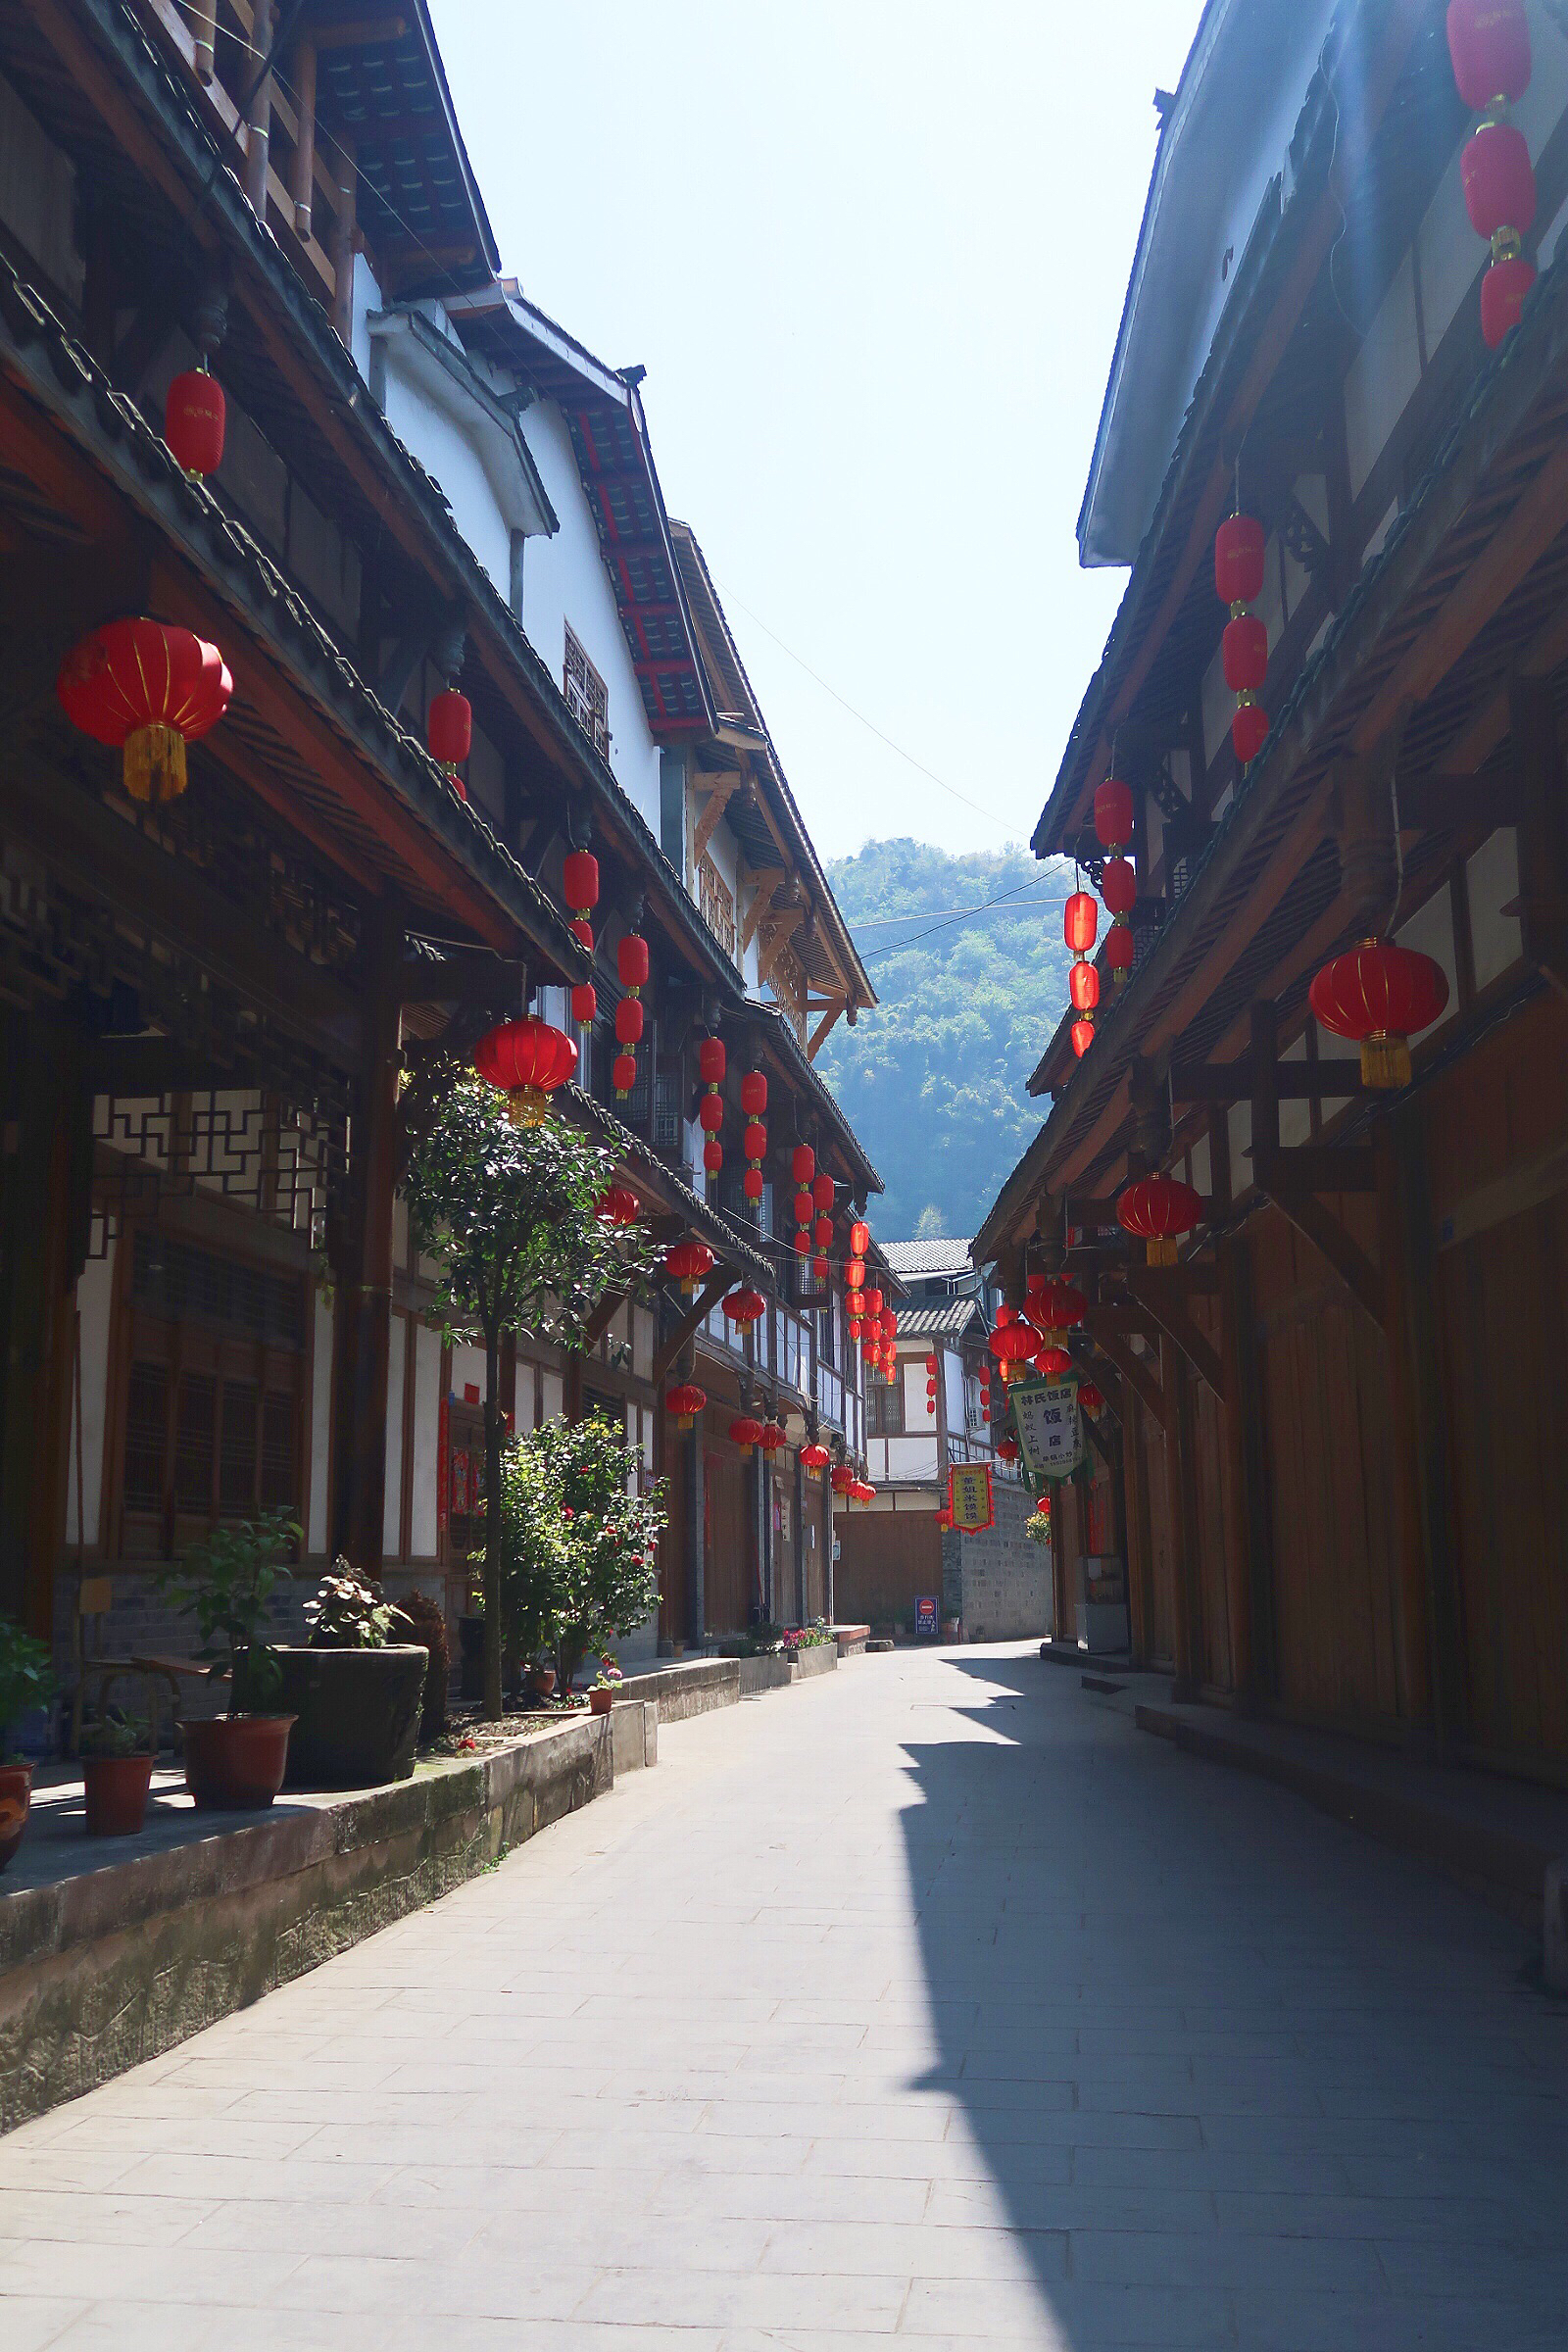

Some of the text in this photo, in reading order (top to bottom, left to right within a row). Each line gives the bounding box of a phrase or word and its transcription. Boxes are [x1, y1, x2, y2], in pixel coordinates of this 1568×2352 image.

[1021, 1388, 1071, 1405] 林氏饭店
[1022, 1410, 1041, 1456] 蚂蚁上树
[1043, 1407, 1062, 1447] 饭店
